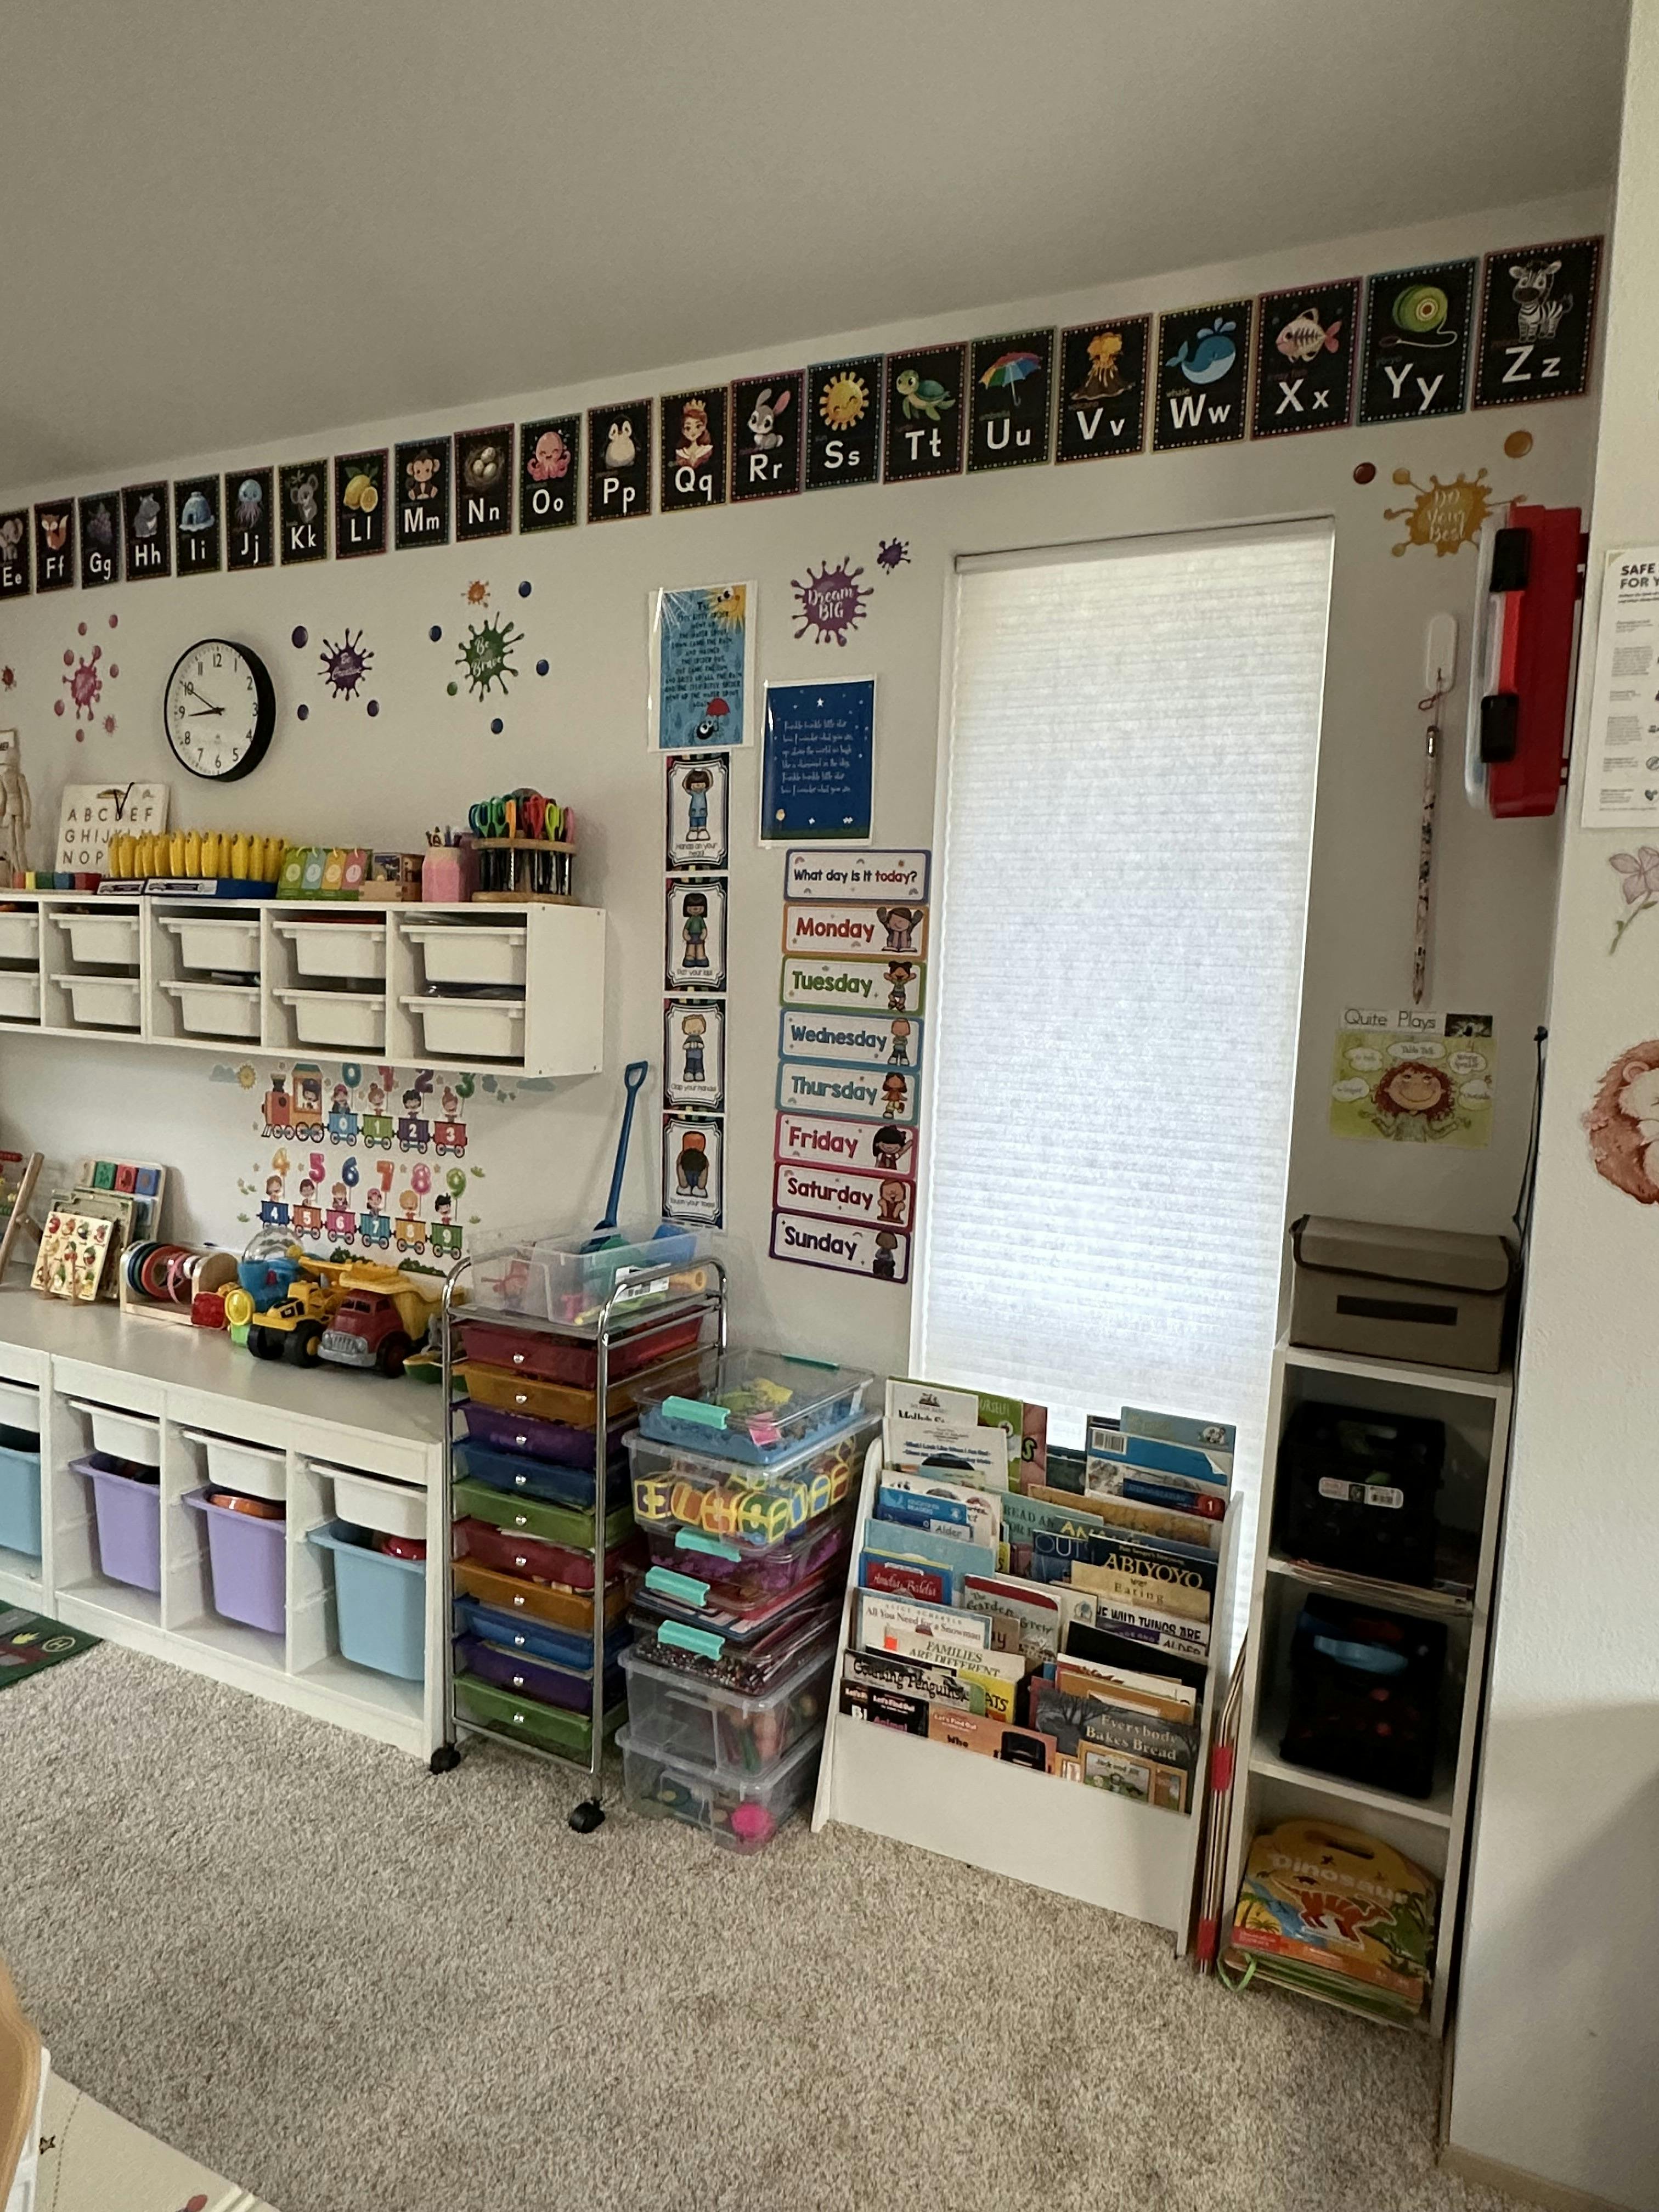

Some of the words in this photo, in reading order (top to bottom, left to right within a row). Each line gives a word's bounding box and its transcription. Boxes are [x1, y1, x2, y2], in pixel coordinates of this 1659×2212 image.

[1620, 563, 1656, 576] SAFE
[1620, 577, 1649, 589] FOR
[808, 588, 853, 606] Dream
[819, 602, 844, 621] BIG
[213, 653, 222, 667] 12
[234, 658, 237, 673] 1
[184, 681, 194, 696] 10
[247, 676, 252, 690] 2
[179, 706, 185, 719] 9
[252, 702, 258, 716] 3
[184, 731, 190, 745] 8
[198, 748, 204, 761] 7
[215, 754, 221, 768] 6
[233, 748, 239, 761] 5
[794, 869, 823, 882] What
[826, 870, 848, 884] day
[851, 870, 860, 881] is
[863, 870, 872, 882] it
[876, 870, 917, 884] today?
[795, 917, 874, 942] Monday
[792, 970, 872, 997] Tuesday
[1344, 1008, 1387, 1027] Quite
[1398, 1011, 1436, 1031] Plays
[791, 1025, 887, 1051] Wednesday
[792, 1076, 878, 1105] Thursday
[339, 1117, 347, 1130] 0
[375, 1121, 381, 1134] 1
[409, 1124, 417, 1138] 2
[446, 1127, 455, 1141] 3
[789, 1126, 858, 1158] Friday
[788, 1177, 873, 1210] Saturday
[270, 1207, 279, 1218] 4
[303, 1211, 312, 1224] 5
[336, 1216, 344, 1229] 6
[373, 1221, 379, 1233] 7
[407, 1224, 414, 1238] 8
[443, 1229, 451, 1243] 9
[785, 1226, 857, 1260] Sunday
[1208, 1500, 1213, 1511] 1
[935, 1525, 962, 1537] Alder
[1104, 1553, 1203, 1589] ABIYOYO
[967, 1600, 1014, 1617] Garden
[881, 1609, 895, 1620] You
[897, 1612, 918, 1625] Need
[941, 1623, 981, 1640] Snowman
[926, 1640, 983, 1663] FAMILIES
[909, 1648, 929, 1660] ARE
[935, 1653, 1000, 1678] DIFFERENT
[1102, 1714, 1178, 1743] Everybody
[947, 1734, 968, 1747] Who
[1086, 1725, 1128, 1748] Bakes
[1133, 1738, 1176, 1760] Bread
[1269, 1853, 1409, 1905] Dinosaur
